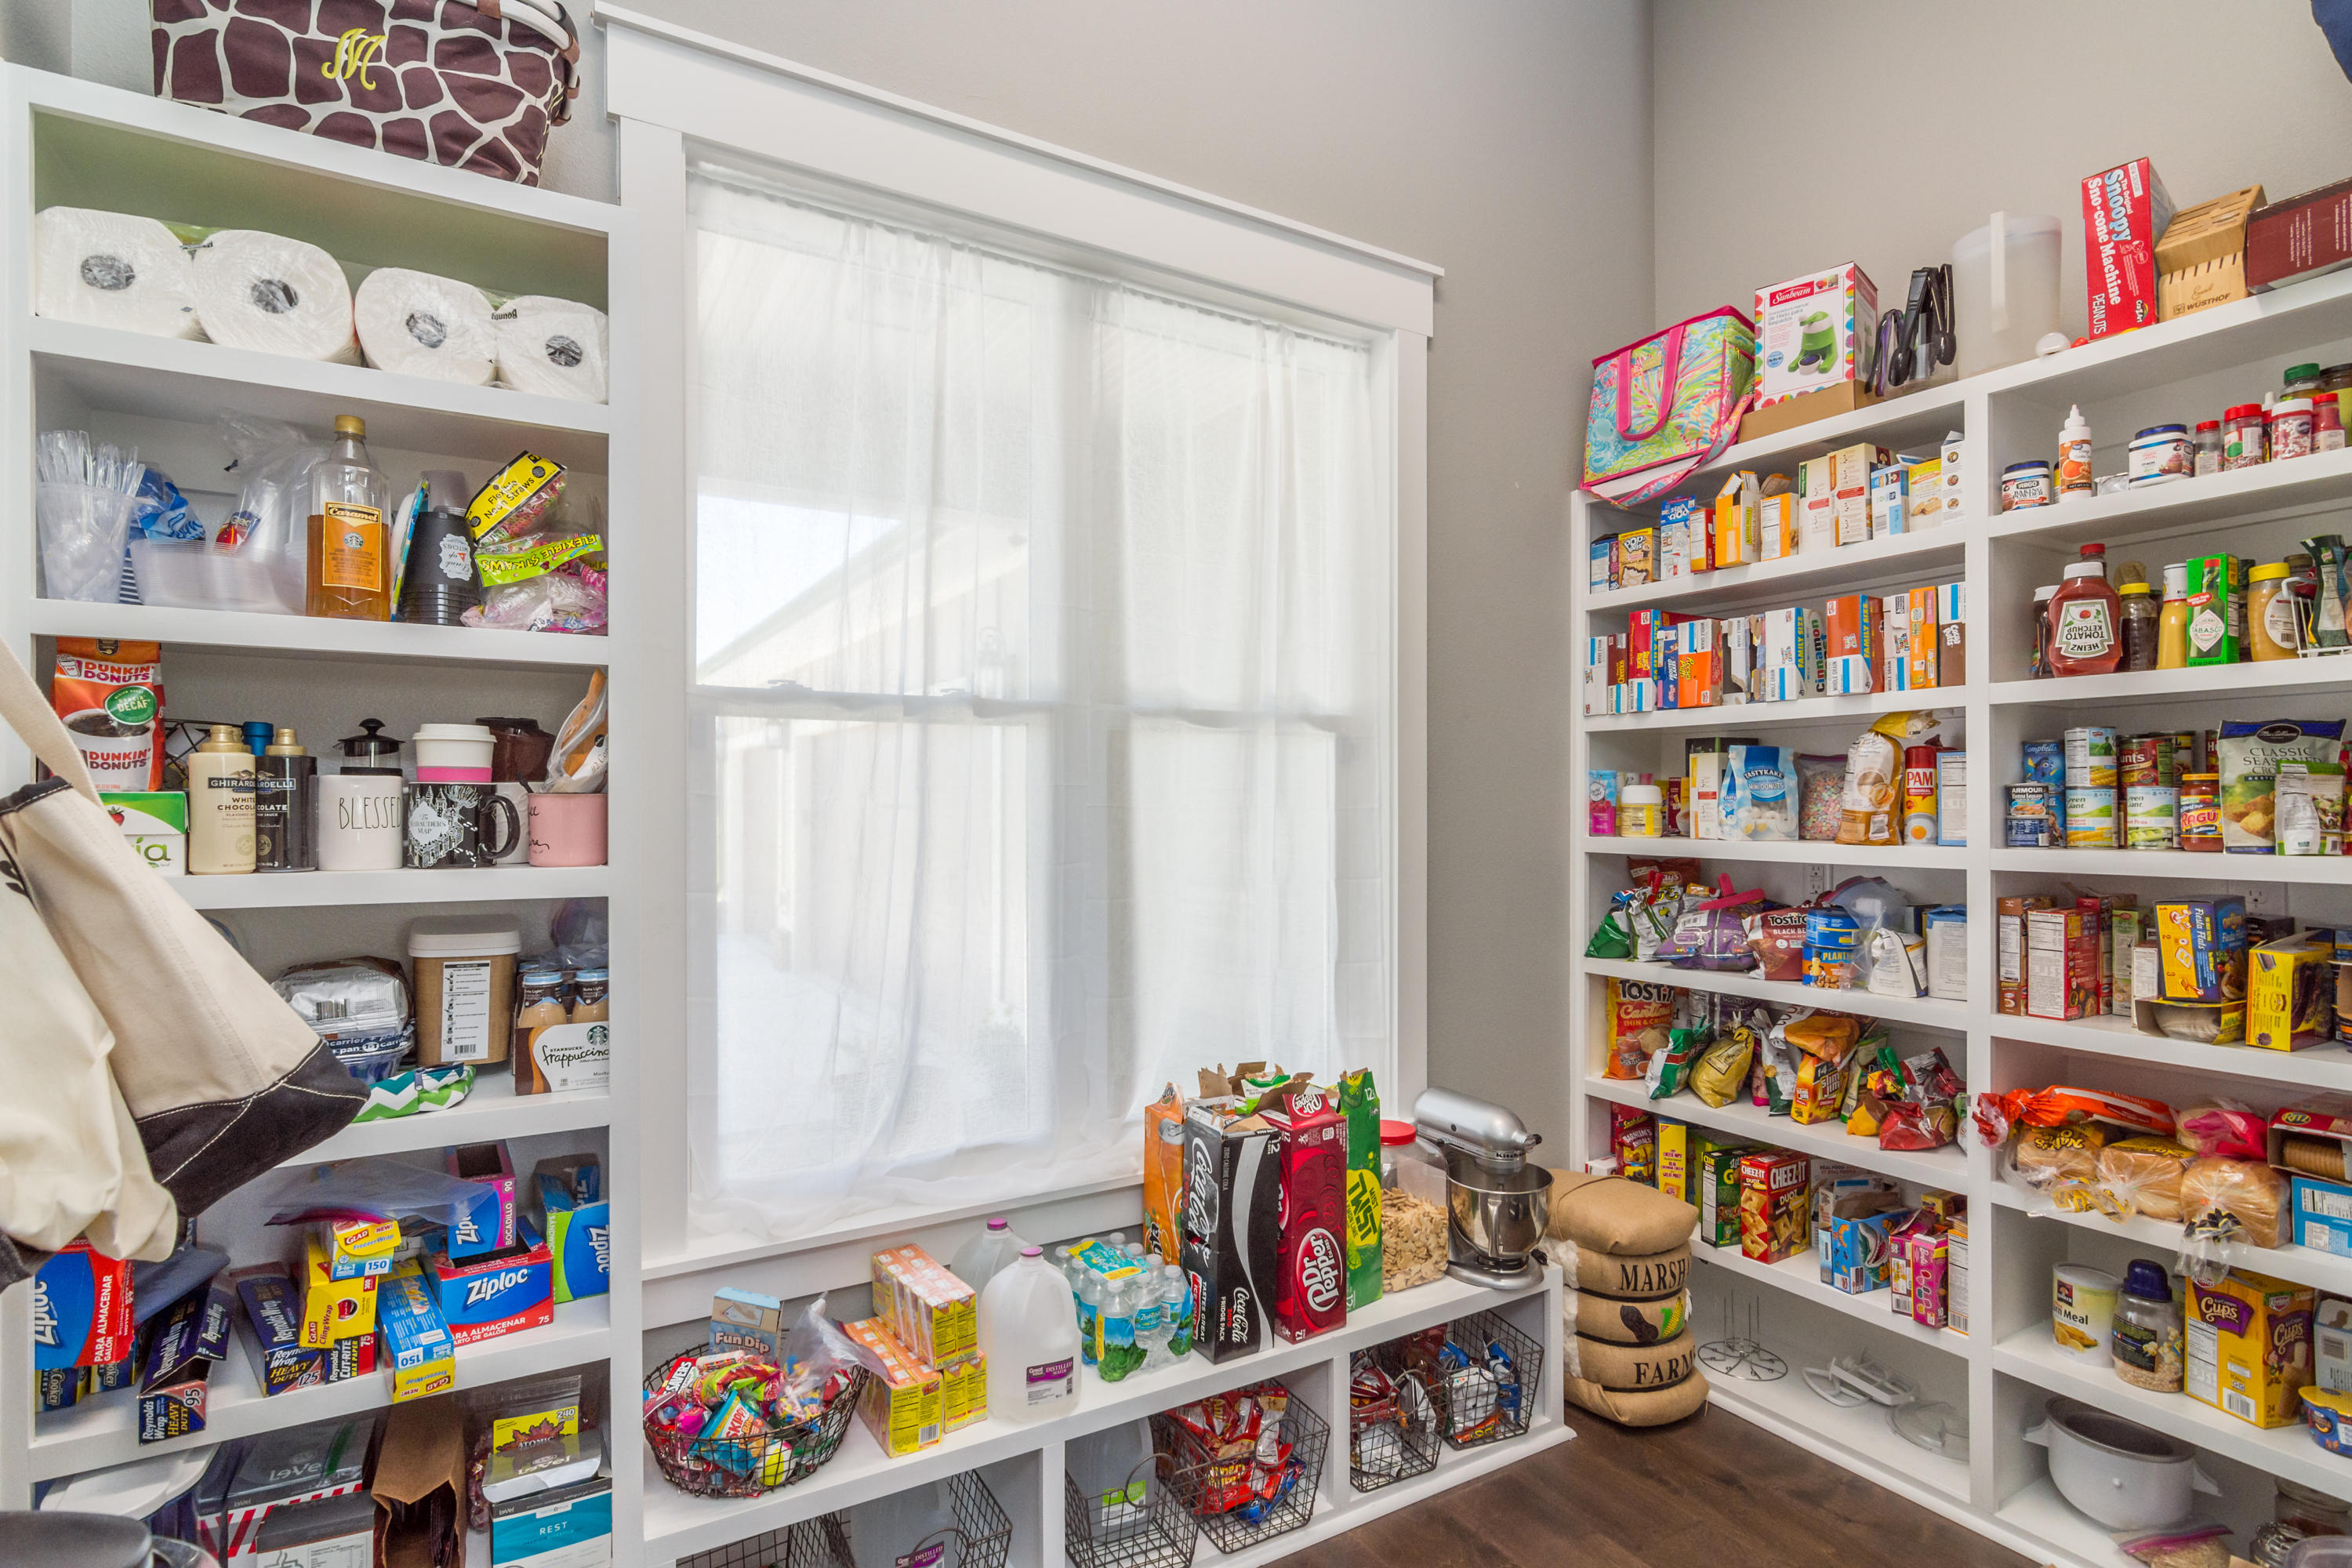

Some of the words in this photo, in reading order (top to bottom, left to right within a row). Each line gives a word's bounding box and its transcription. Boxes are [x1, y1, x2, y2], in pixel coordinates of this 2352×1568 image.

[2104, 169, 2132, 242] Snoopy
[2123, 190, 2133, 215] Original
[2100, 241, 2122, 305] Machine
[1773, 286, 1811, 305] Sunbeam
[491, 308, 517, 321] Bounty
[2092, 293, 2107, 335] PEANUTS
[484, 502, 503, 520] Neon
[506, 477, 535, 503] Straws
[488, 478, 518, 504] Flexible
[328, 506, 379, 523] Caramel
[542, 535, 597, 560] FLEXIBLE
[481, 554, 540, 573] STRAWS
[2065, 631, 2105, 641] TOMATO
[1811, 619, 1825, 693] Cinnamon
[84, 670, 151, 684] DONUTS
[117, 699, 150, 713] DECAF
[89, 748, 151, 762] DUNKIN'
[2025, 744, 2059, 753] Campbell's
[2119, 752, 2145, 763] unt's
[2249, 747, 2314, 757] CLASSIC
[89, 758, 147, 771] DONUTS
[1744, 769, 1784, 779] TASTYKAKE
[1907, 771, 1933, 786] PAM
[210, 779, 256, 788] GHIRARD
[339, 796, 402, 829] BLESSED
[2194, 908, 2204, 930] Fiesta
[2196, 931, 2205, 949] Flats
[1619, 980, 1675, 1003] TOSTIT
[329, 1037, 365, 1047] carrier
[339, 1046, 361, 1056] pan
[1817, 1065, 1827, 1077] 14
[2283, 1112, 2310, 1123] RITZ
[1271, 1136, 1281, 1153] 12
[1623, 1129, 1652, 1143] BARNUM'S
[1741, 1165, 1765, 1179] CHEEZ-IT
[1770, 1161, 1807, 1189] CHEEZ-IT
[504, 1181, 513, 1192] 90
[1347, 1171, 1377, 1242] TWST
[1368, 1187, 1379, 1208] MIST
[1779, 1191, 1798, 1205] DUOZ
[345, 1229, 368, 1245] GLAD
[375, 1223, 394, 1233] NEW!
[1350, 1221, 1359, 1239] LIME
[353, 1233, 394, 1250] FreezerWrap
[586, 1223, 609, 1274] Ziploc
[368, 1260, 387, 1270] 150
[1303, 1256, 1320, 1286] Dr
[1307, 1235, 1339, 1312] Pepper
[1620, 1257, 1692, 1292] MARSH
[466, 1267, 529, 1306] Ziploc
[96, 1275, 113, 1332] ALMACENAR
[2201, 1297, 2238, 1323] Cups
[539, 1315, 550, 1324] 75
[1232, 1287, 1250, 1344] Coca-Cola
[2063, 1310, 2089, 1325] Meal
[308, 1321, 317, 1343] GLAD
[320, 1305, 332, 1345] ClingWrap
[470, 1316, 526, 1337] ALMACENAR
[482, 1327, 506, 1339] GALÓN
[1196, 1311, 1205, 1343] GREAT
[360, 1335, 372, 1347] 75
[714, 1332, 743, 1347] Fun
[744, 1335, 771, 1355] Dip
[1294, 1329, 1303, 1341] 12
[2274, 1321, 2304, 1355] Cups
[94, 1334, 105, 1363] PARA
[103, 1335, 114, 1362] GALÓN
[270, 1355, 297, 1368] Wrap
[329, 1349, 339, 1381] Reynolds
[339, 1339, 351, 1379] CUT-RITE
[401, 1352, 421, 1367] 150
[1045, 1360, 1073, 1373] DISTILLED
[1633, 1349, 1696, 1385] FARM
[270, 1360, 310, 1378] HEAVY
[297, 1370, 319, 1386] 125
[405, 1370, 448, 1385] FreezerWrap
[665, 1359, 693, 1396] SAVERS
[1028, 1365, 1044, 1374] Great
[271, 1373, 303, 1385] DUTY
[426, 1377, 450, 1392] GLAD
[49, 1372, 64, 1406] Cooker
[183, 1388, 201, 1406] 95
[401, 1388, 419, 1398] NEW!
[143, 1400, 154, 1440] Reynolds
[167, 1402, 180, 1436] HEAVY
[180, 1406, 189, 1432] DUTY
[556, 1407, 575, 1420] 240
[154, 1416, 165, 1439] Wrap
[725, 1406, 748, 1442] SKIPPY
[517, 1436, 555, 1450] ATOMIC
[539, 1521, 568, 1536] REST
[914, 1544, 944, 1563] DISTILLED
